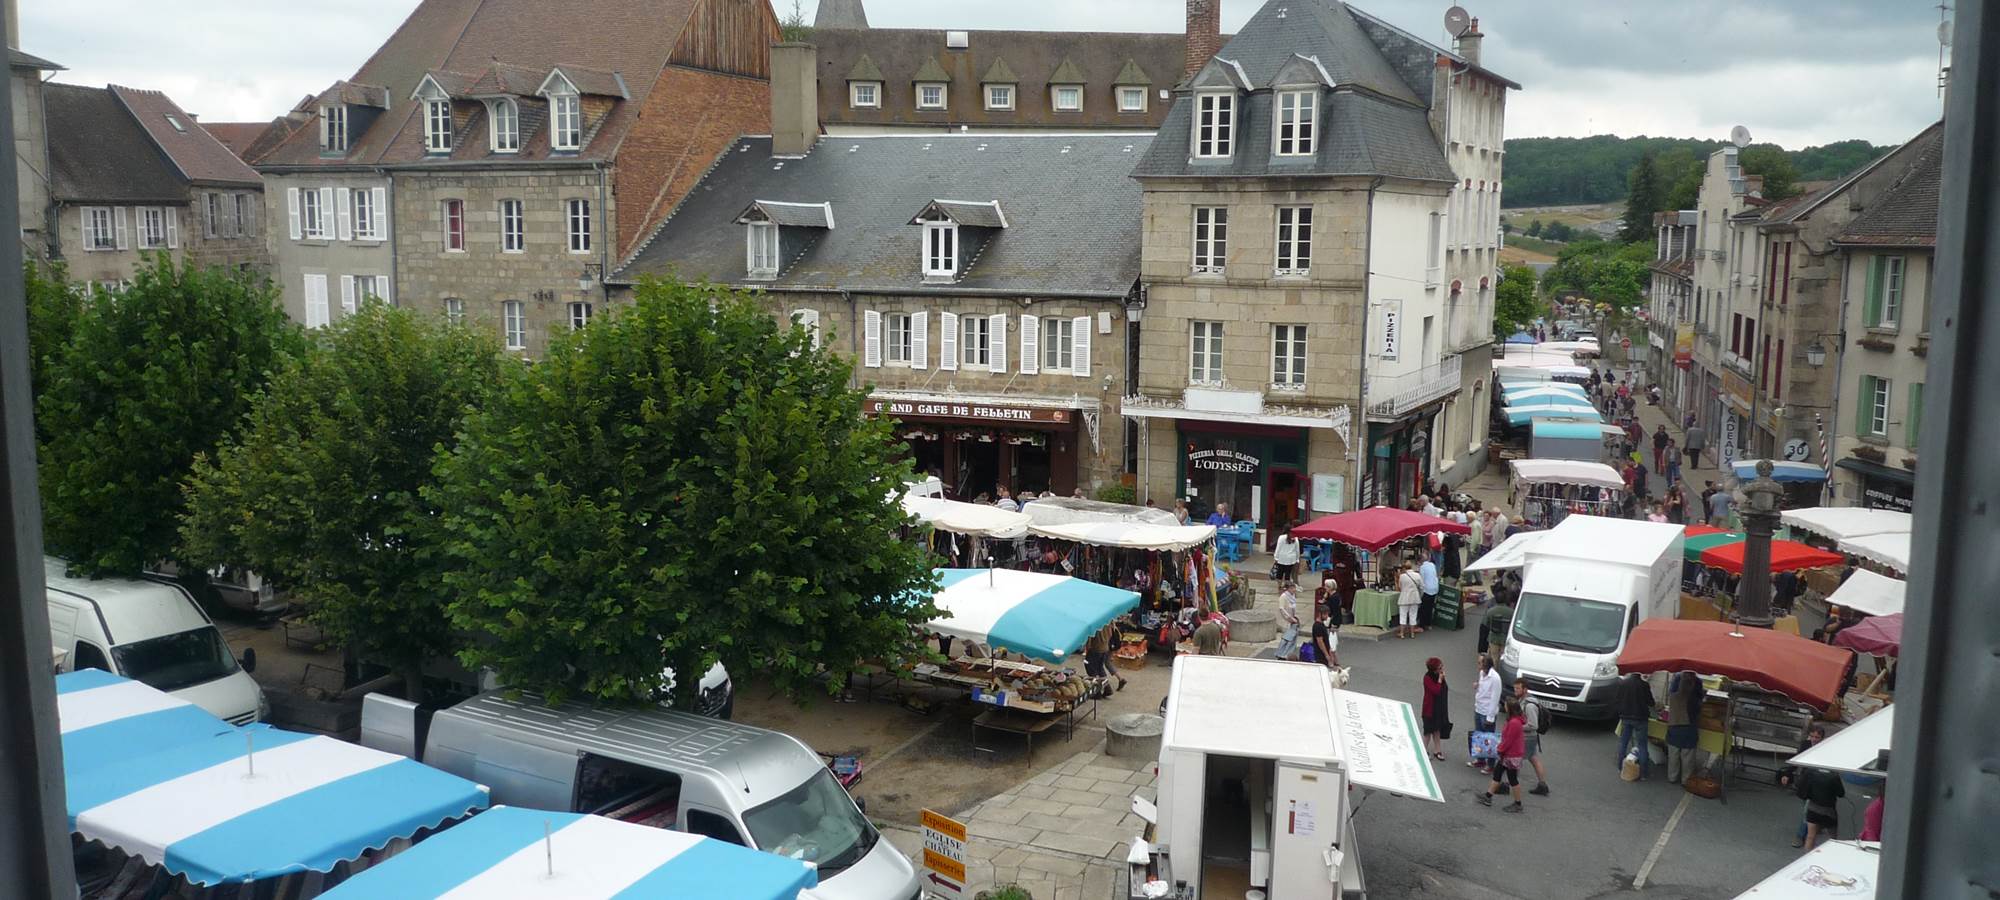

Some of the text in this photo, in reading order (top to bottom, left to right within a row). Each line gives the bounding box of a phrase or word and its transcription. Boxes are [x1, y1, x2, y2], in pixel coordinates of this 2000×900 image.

[1386, 312, 1395, 352] PIZZERIA
[875, 403, 1031, 419] GAND CAFE DE FELLETIN
[1724, 408, 1736, 464] CADEAUX
[1189, 449, 1260, 466] PIZZERIA GRILL GLACIER
[1790, 445, 1805, 456] 30
[1195, 460, 1254, 472] L'ODYSSÉE
[923, 812, 966, 837] Exposition
